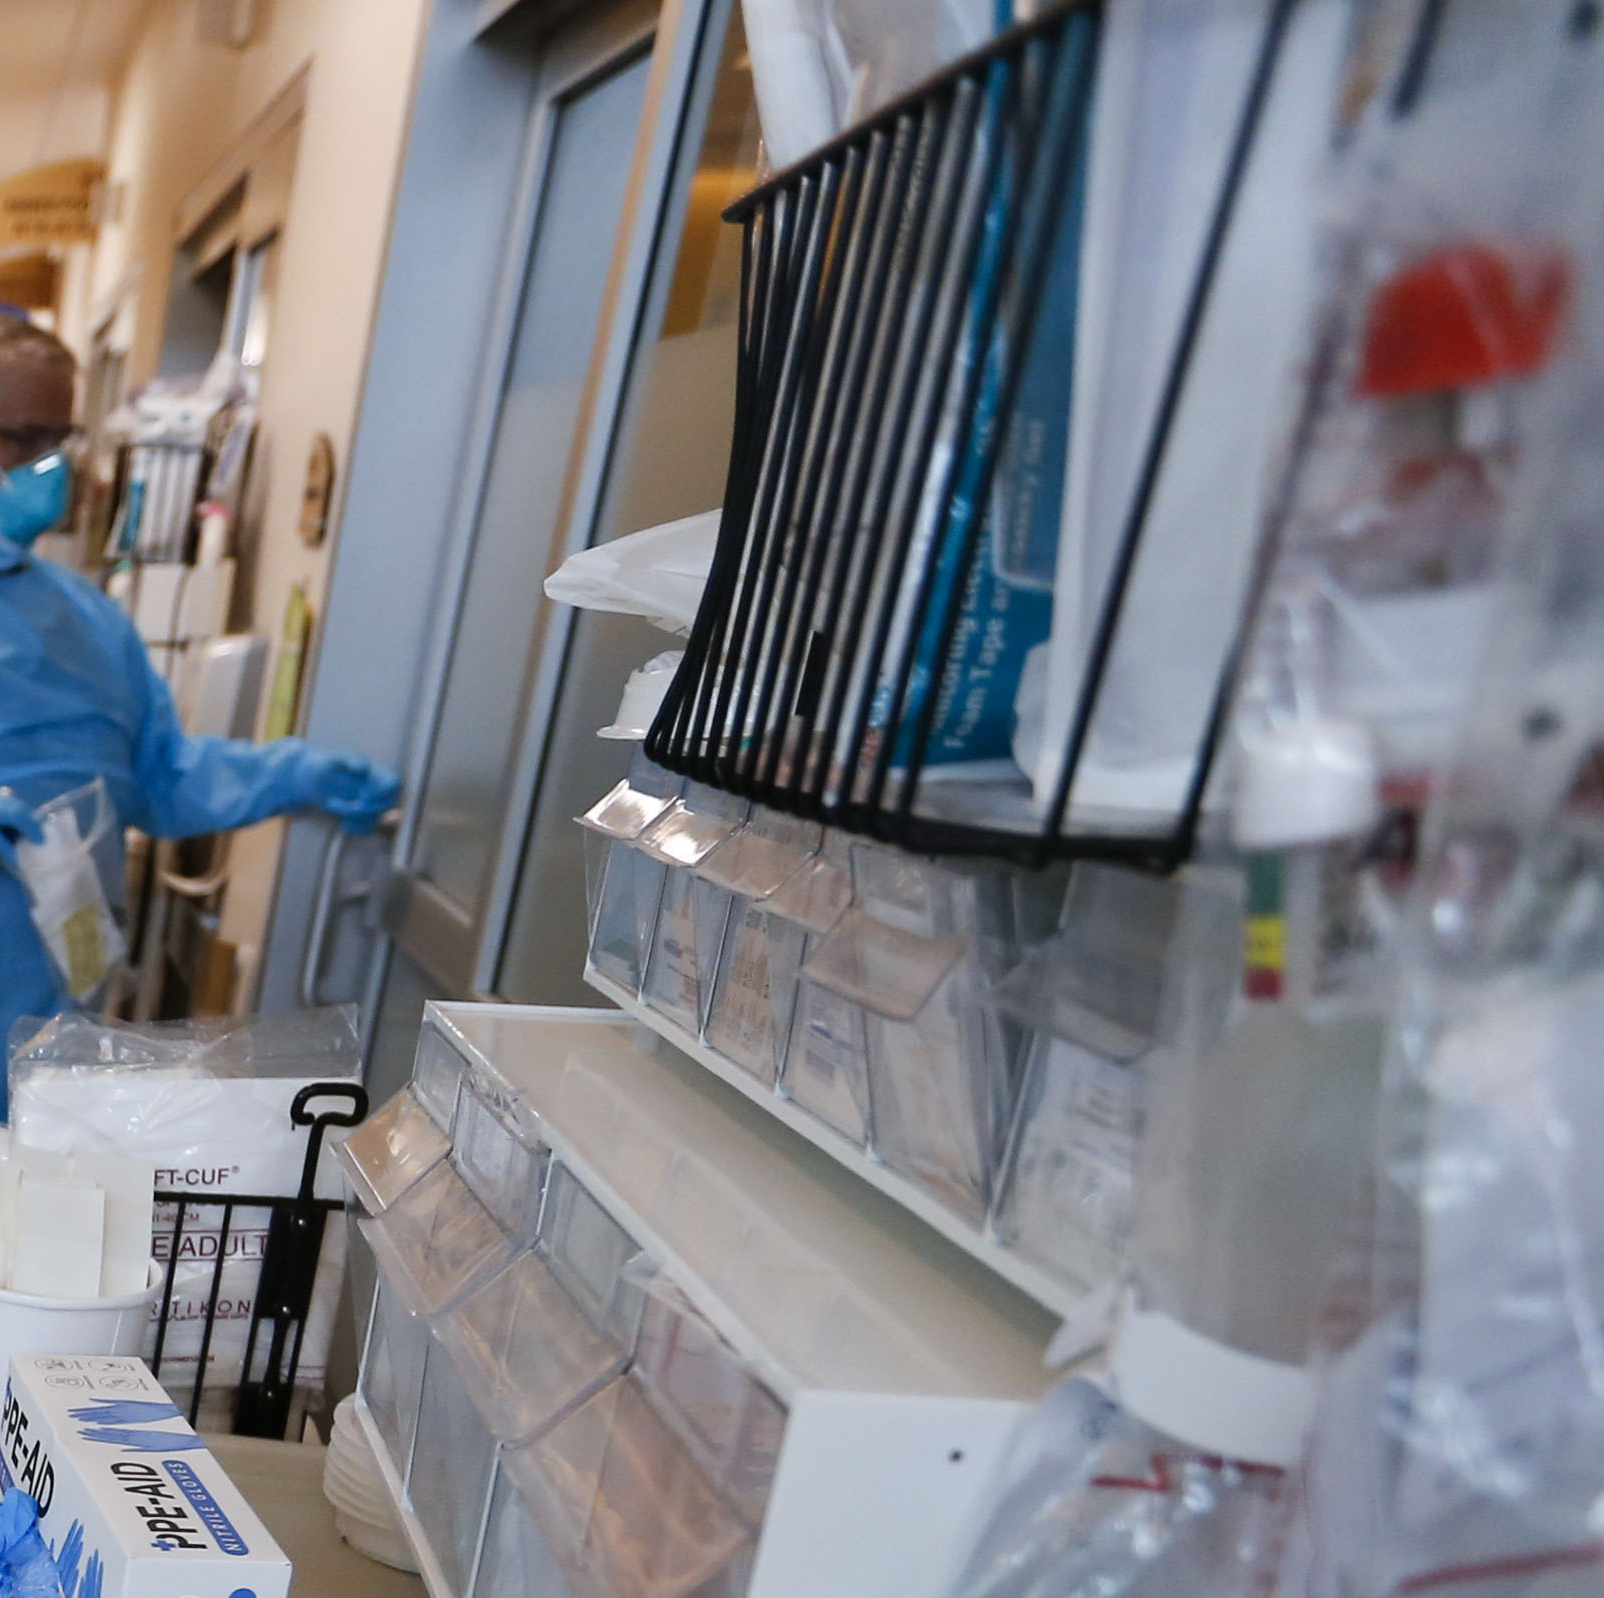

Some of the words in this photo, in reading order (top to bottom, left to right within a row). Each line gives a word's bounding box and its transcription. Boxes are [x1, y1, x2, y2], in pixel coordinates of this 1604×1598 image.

[154, 1166, 239, 1186] FT-CUF®
[168, 1463, 207, 1501] GLOVES
[110, 1462, 208, 1550] PPE-AID
[199, 1506, 243, 1552] NITRILE
